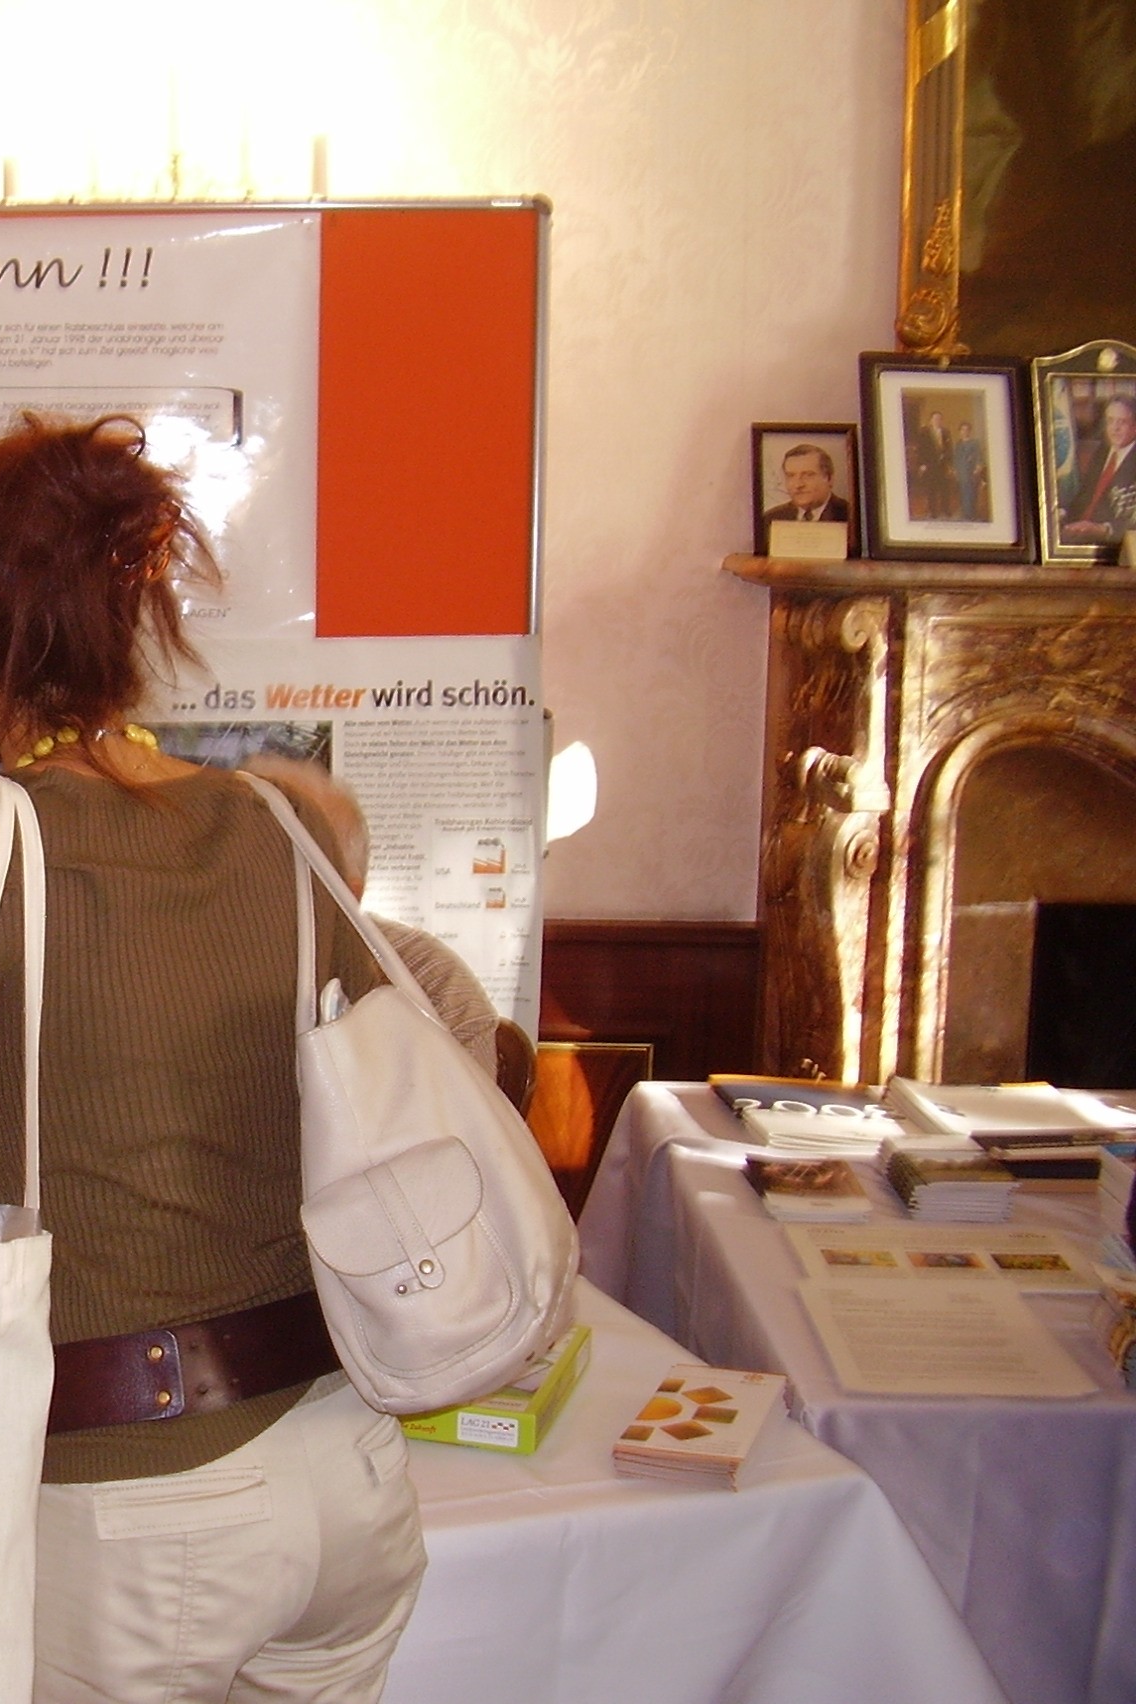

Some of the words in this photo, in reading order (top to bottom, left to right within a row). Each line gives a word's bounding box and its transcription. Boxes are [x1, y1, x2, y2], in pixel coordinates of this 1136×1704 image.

[95, 246, 155, 290] !!!
[203, 682, 257, 711] das
[264, 682, 367, 711] Wetter
[371, 679, 434, 709] wird
[441, 679, 536, 708] schön.
